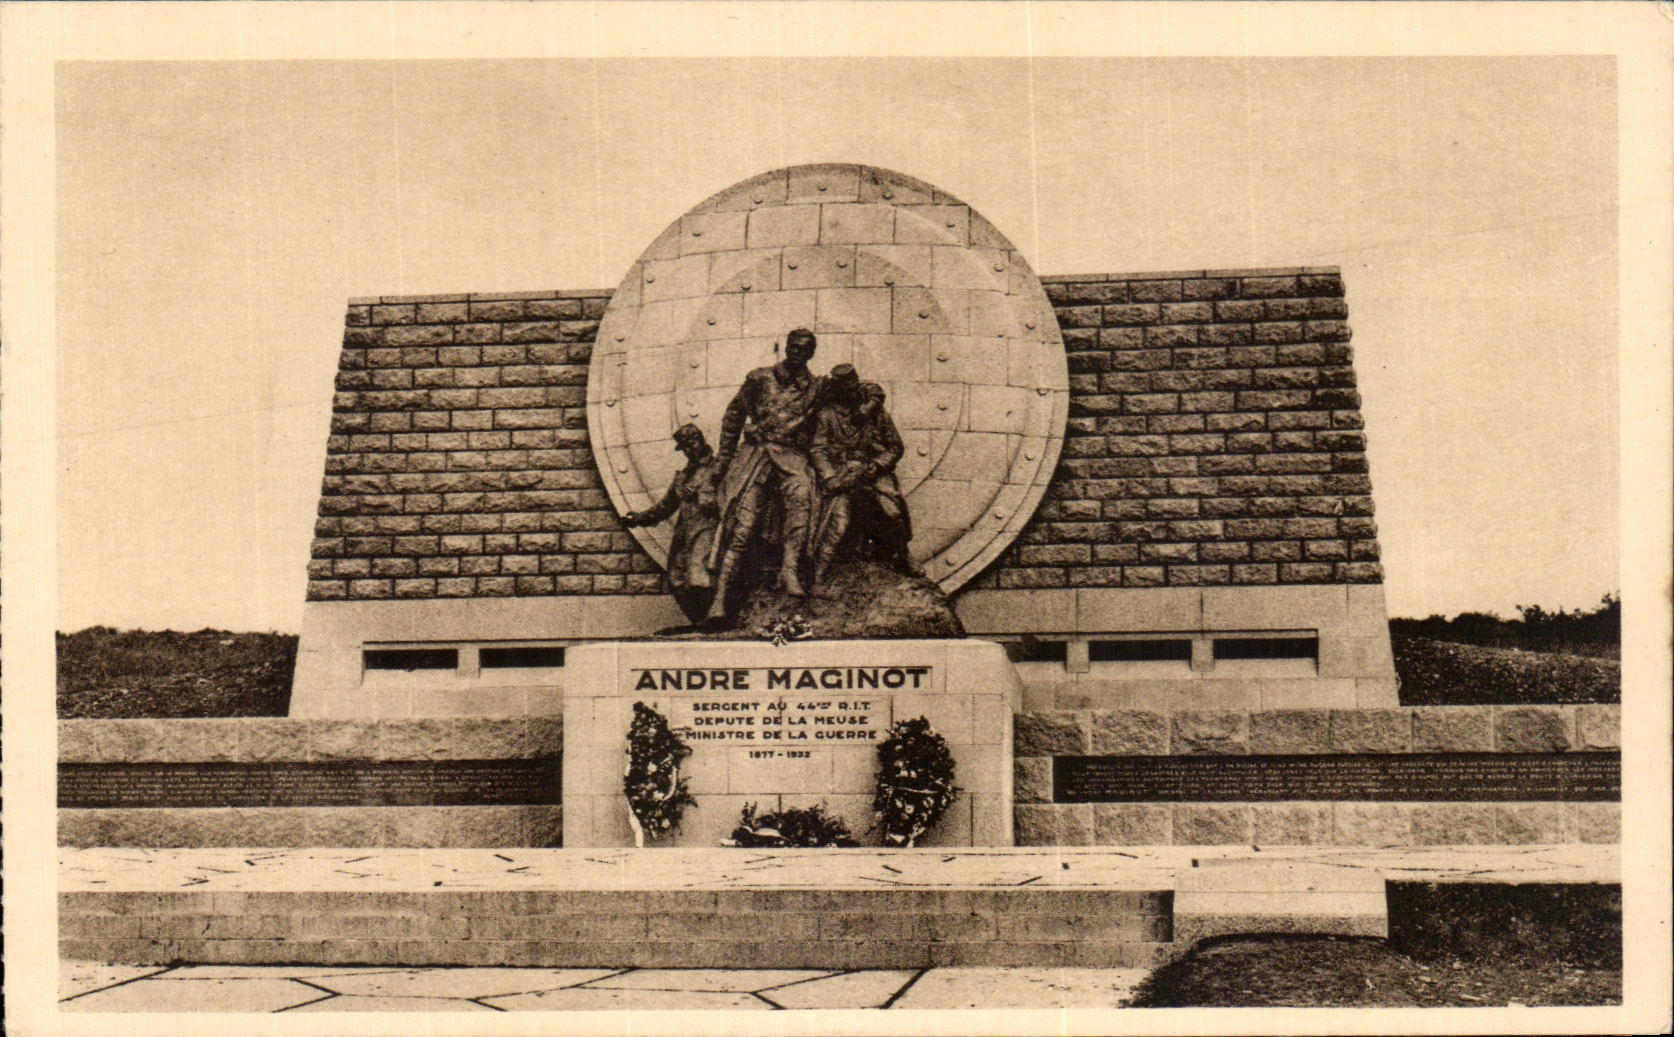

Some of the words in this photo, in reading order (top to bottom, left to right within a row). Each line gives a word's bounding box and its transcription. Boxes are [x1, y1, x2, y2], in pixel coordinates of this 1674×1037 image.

[636, 670, 749, 690] ANDRE
[768, 669, 928, 690] MAGINOT
[693, 703, 760, 711] SERGENT
[768, 702, 786, 711] AU
[694, 717, 755, 726] DEPUTE
[763, 716, 782, 726] DE
[788, 716, 807, 726] LA
[815, 716, 869, 725] MEUSE
[685, 730, 755, 740] MINISTRE
[763, 730, 782, 740] DE
[788, 730, 808, 740] LA
[815, 730, 877, 740] GUERRE
[749, 751, 775, 759] 1877
[786, 751, 811, 759] 1932
